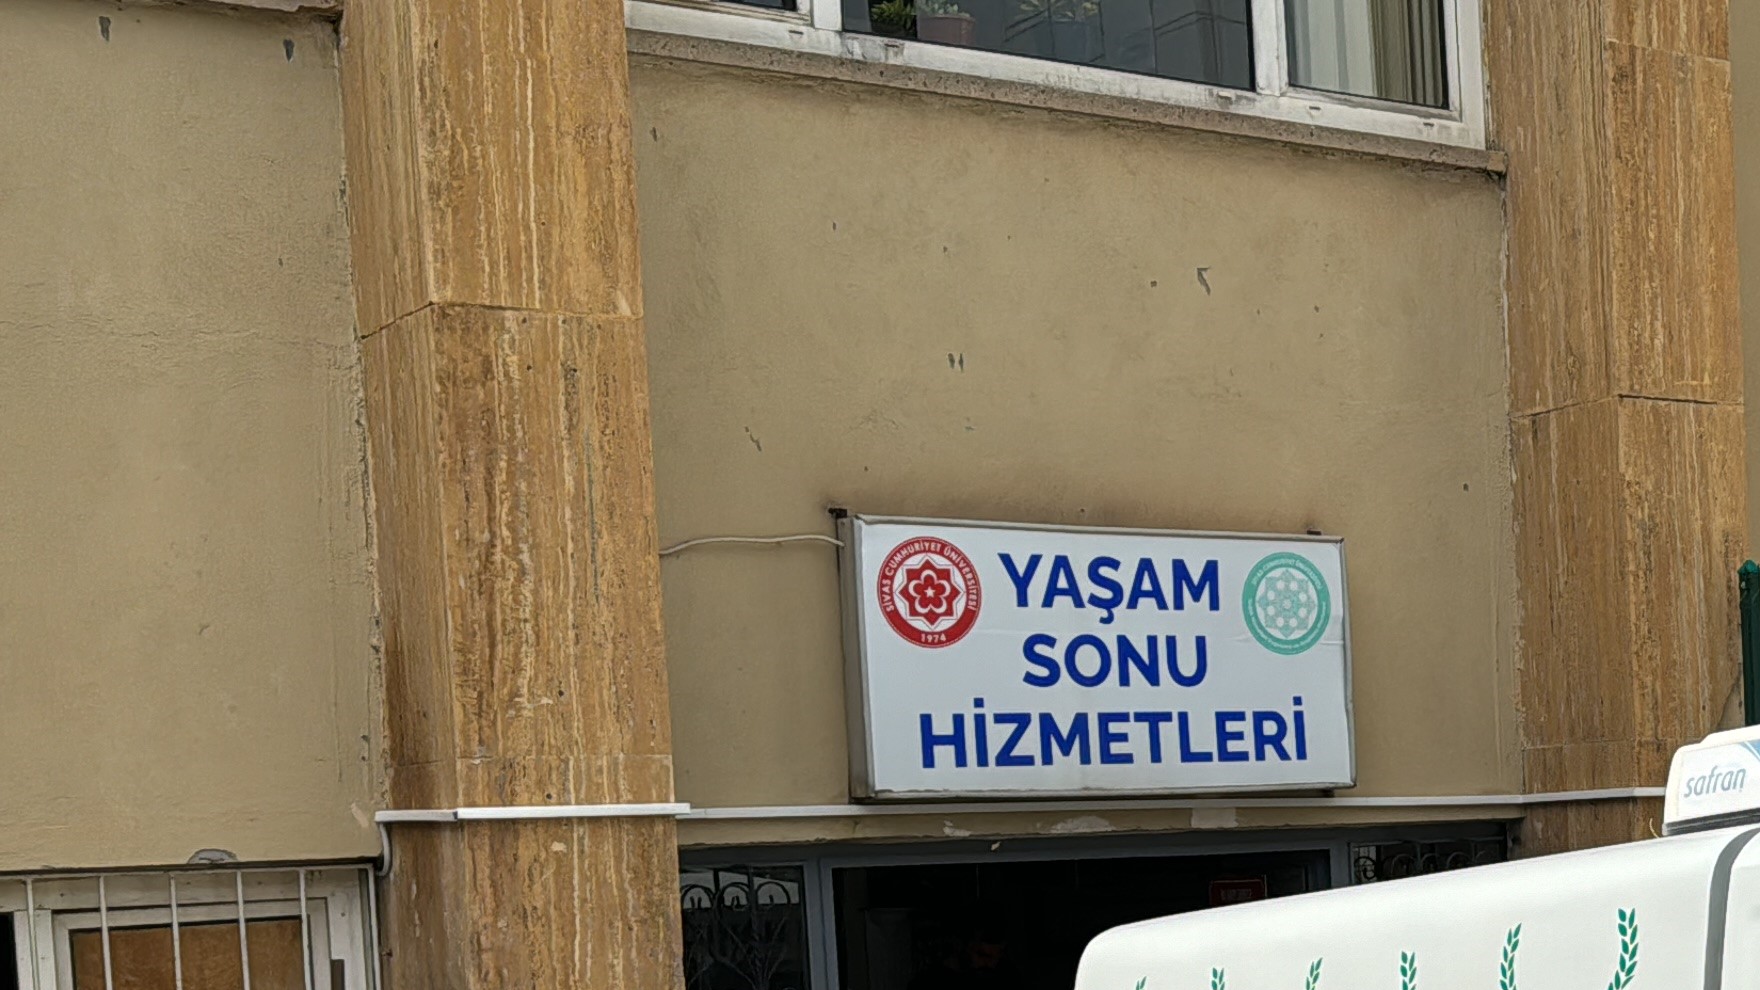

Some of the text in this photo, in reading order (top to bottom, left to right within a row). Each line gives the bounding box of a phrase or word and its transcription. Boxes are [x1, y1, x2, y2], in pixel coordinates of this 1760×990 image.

[997, 552, 1221, 625] YAŞAM
[920, 633, 947, 643] 1974
[1022, 633, 1208, 688] SONU
[918, 696, 1308, 769] HİZMETLERİ
[1683, 765, 1747, 798] safran
